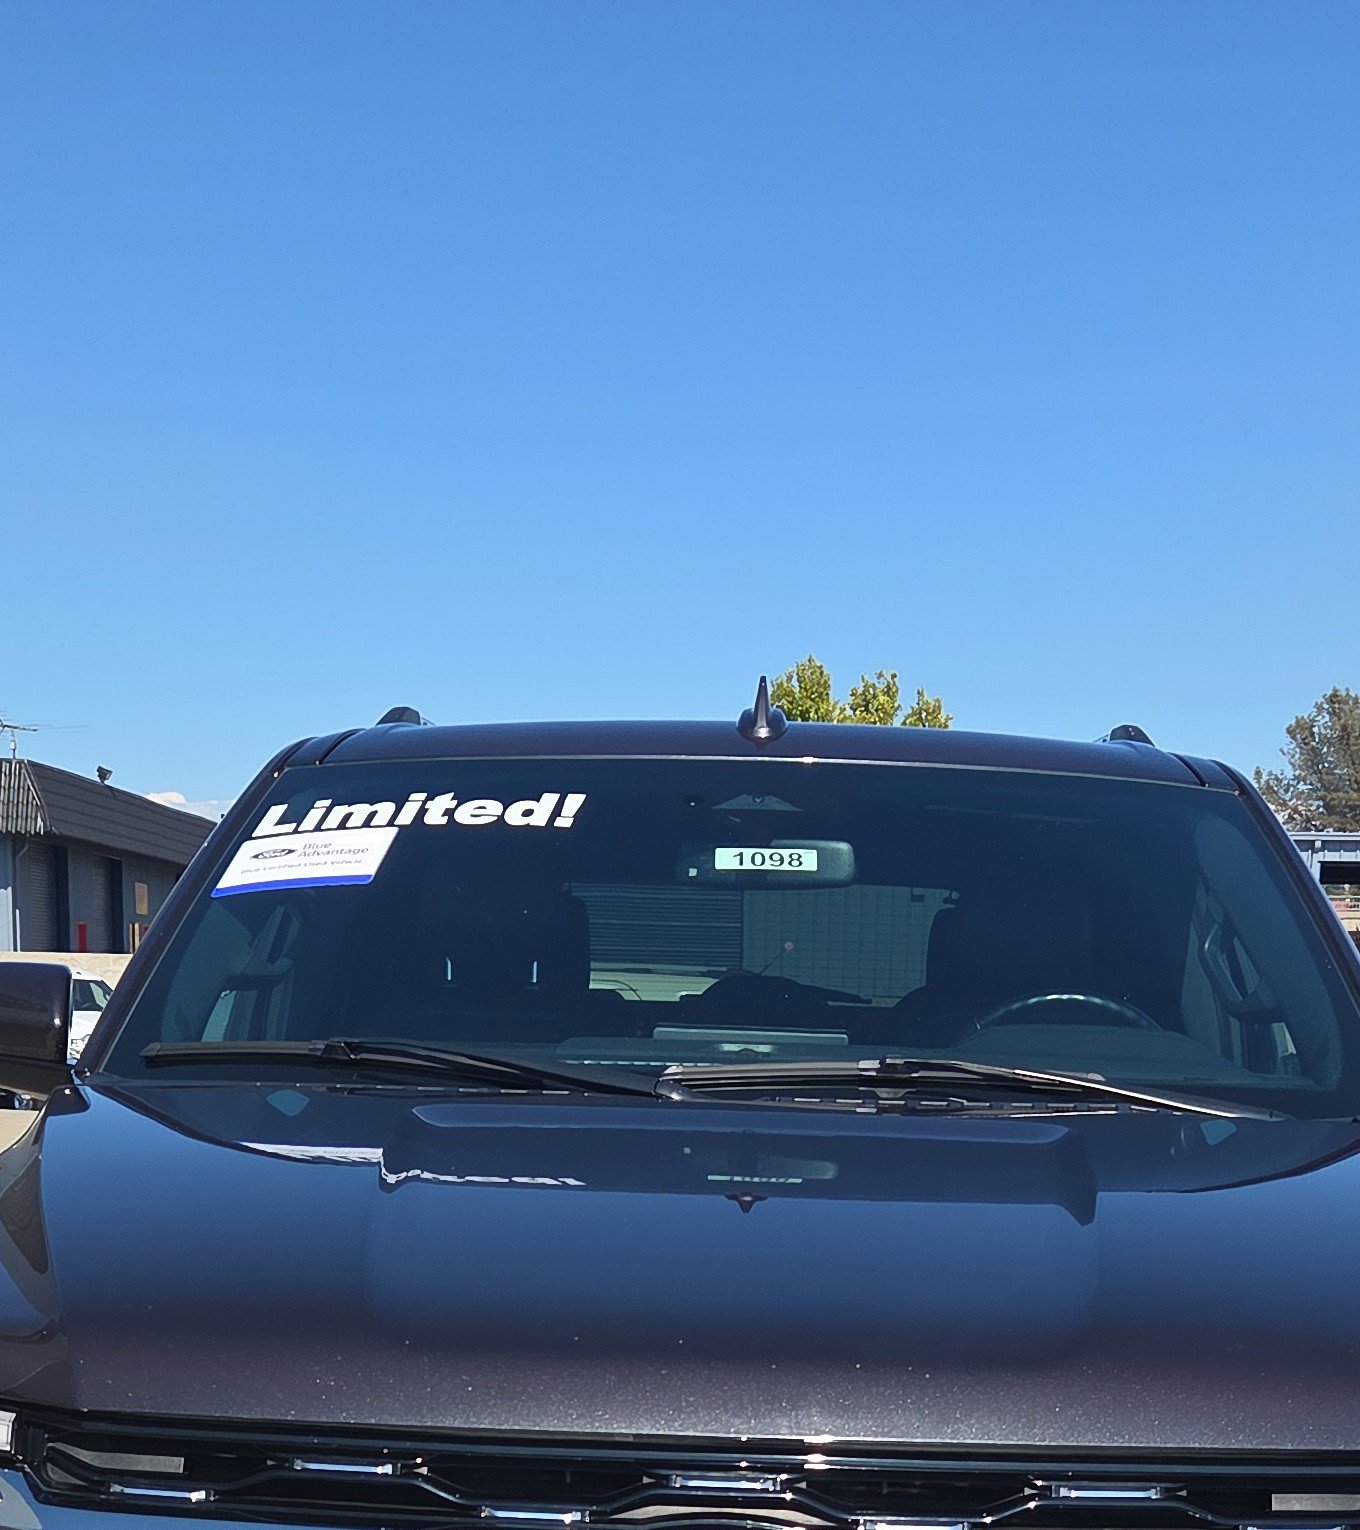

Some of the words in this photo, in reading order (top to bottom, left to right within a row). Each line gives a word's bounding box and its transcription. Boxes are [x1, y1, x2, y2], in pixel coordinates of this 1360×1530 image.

[251, 792, 587, 838] Limited!
[297, 847, 369, 858] Advantage
[733, 851, 804, 868] 1098
